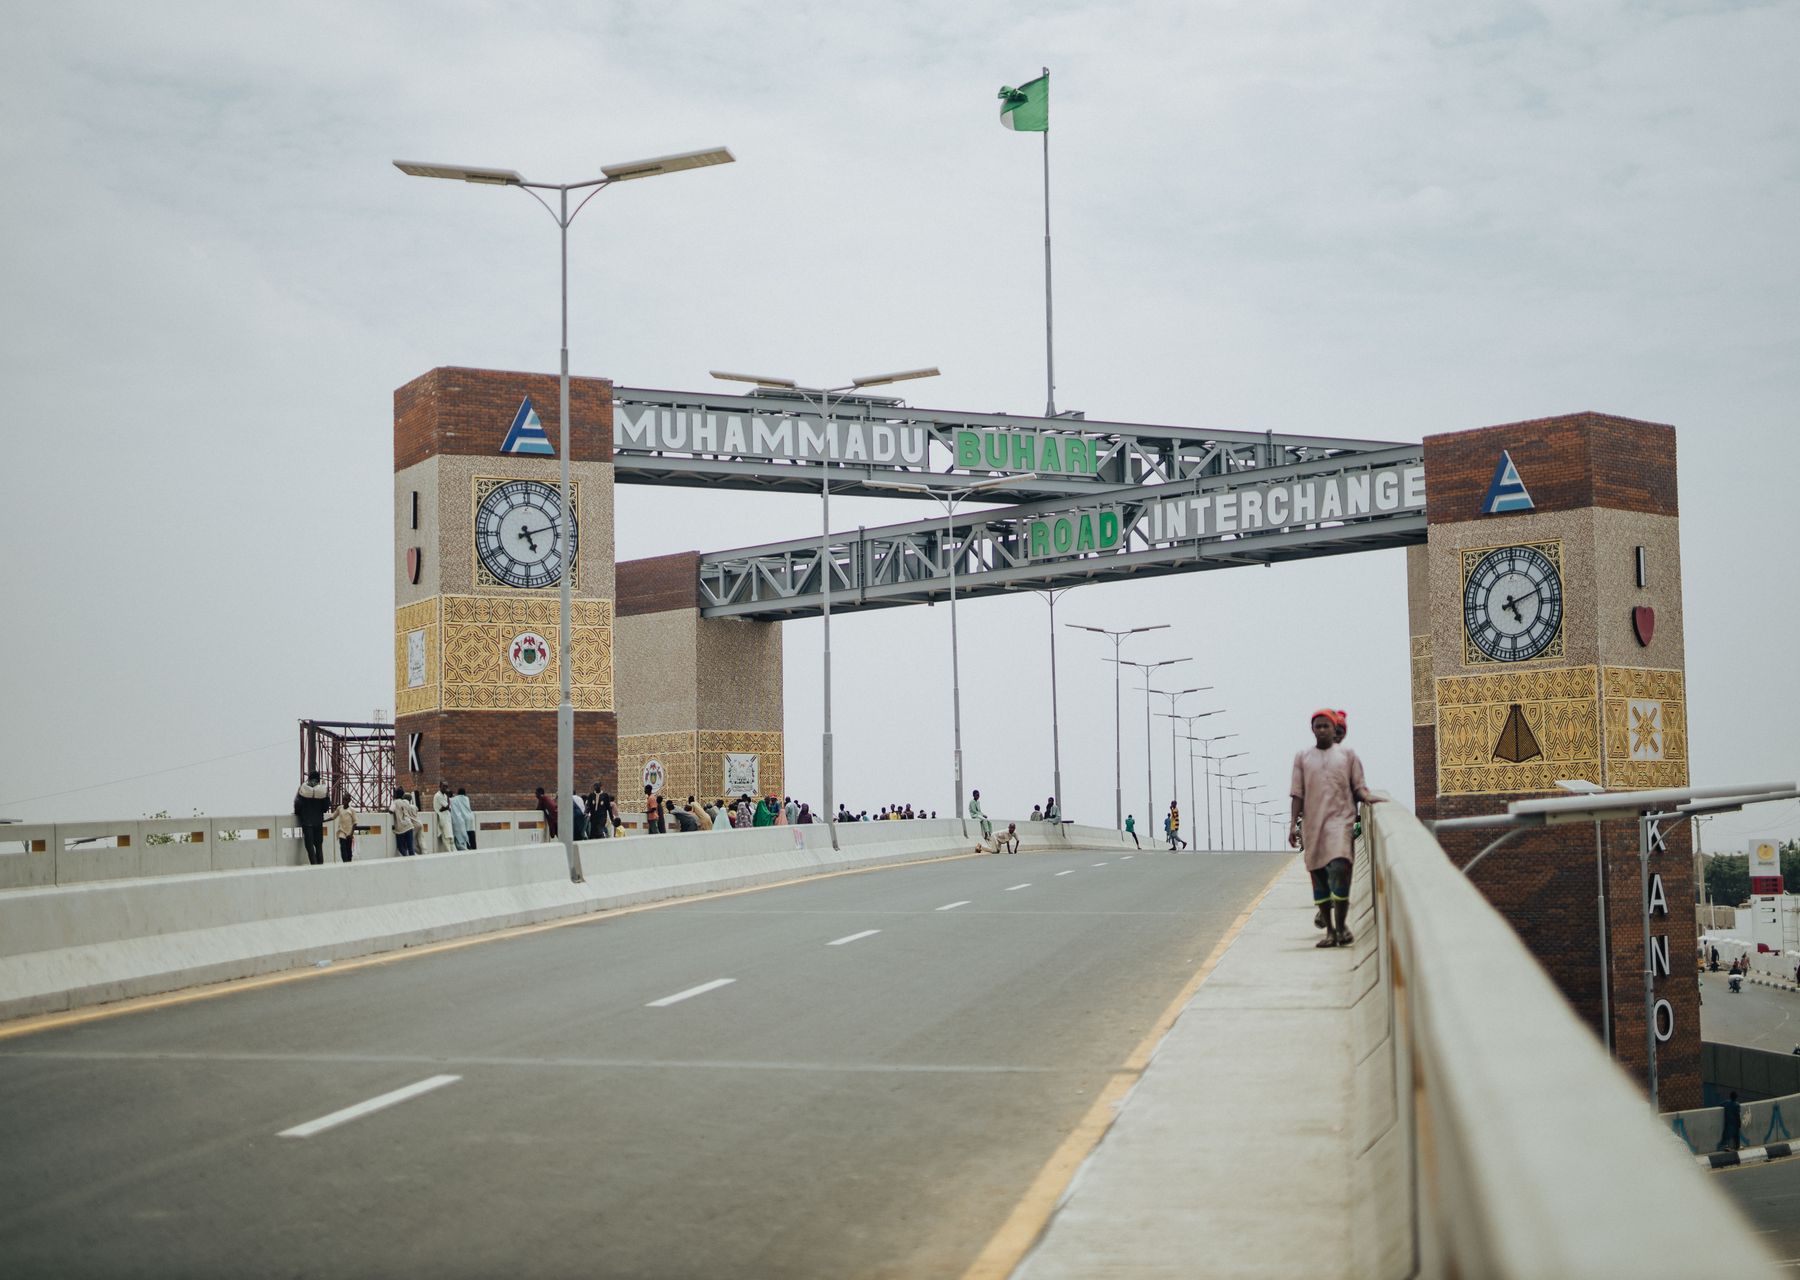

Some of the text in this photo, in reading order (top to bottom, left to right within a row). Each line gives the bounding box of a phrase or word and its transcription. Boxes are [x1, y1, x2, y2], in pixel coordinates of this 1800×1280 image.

[613, 408, 1096, 474] MUHAMMADU BUHARI
[1030, 467, 1426, 557] ROAD INTERCHANGE
[1646, 811, 1674, 1042] KANO
